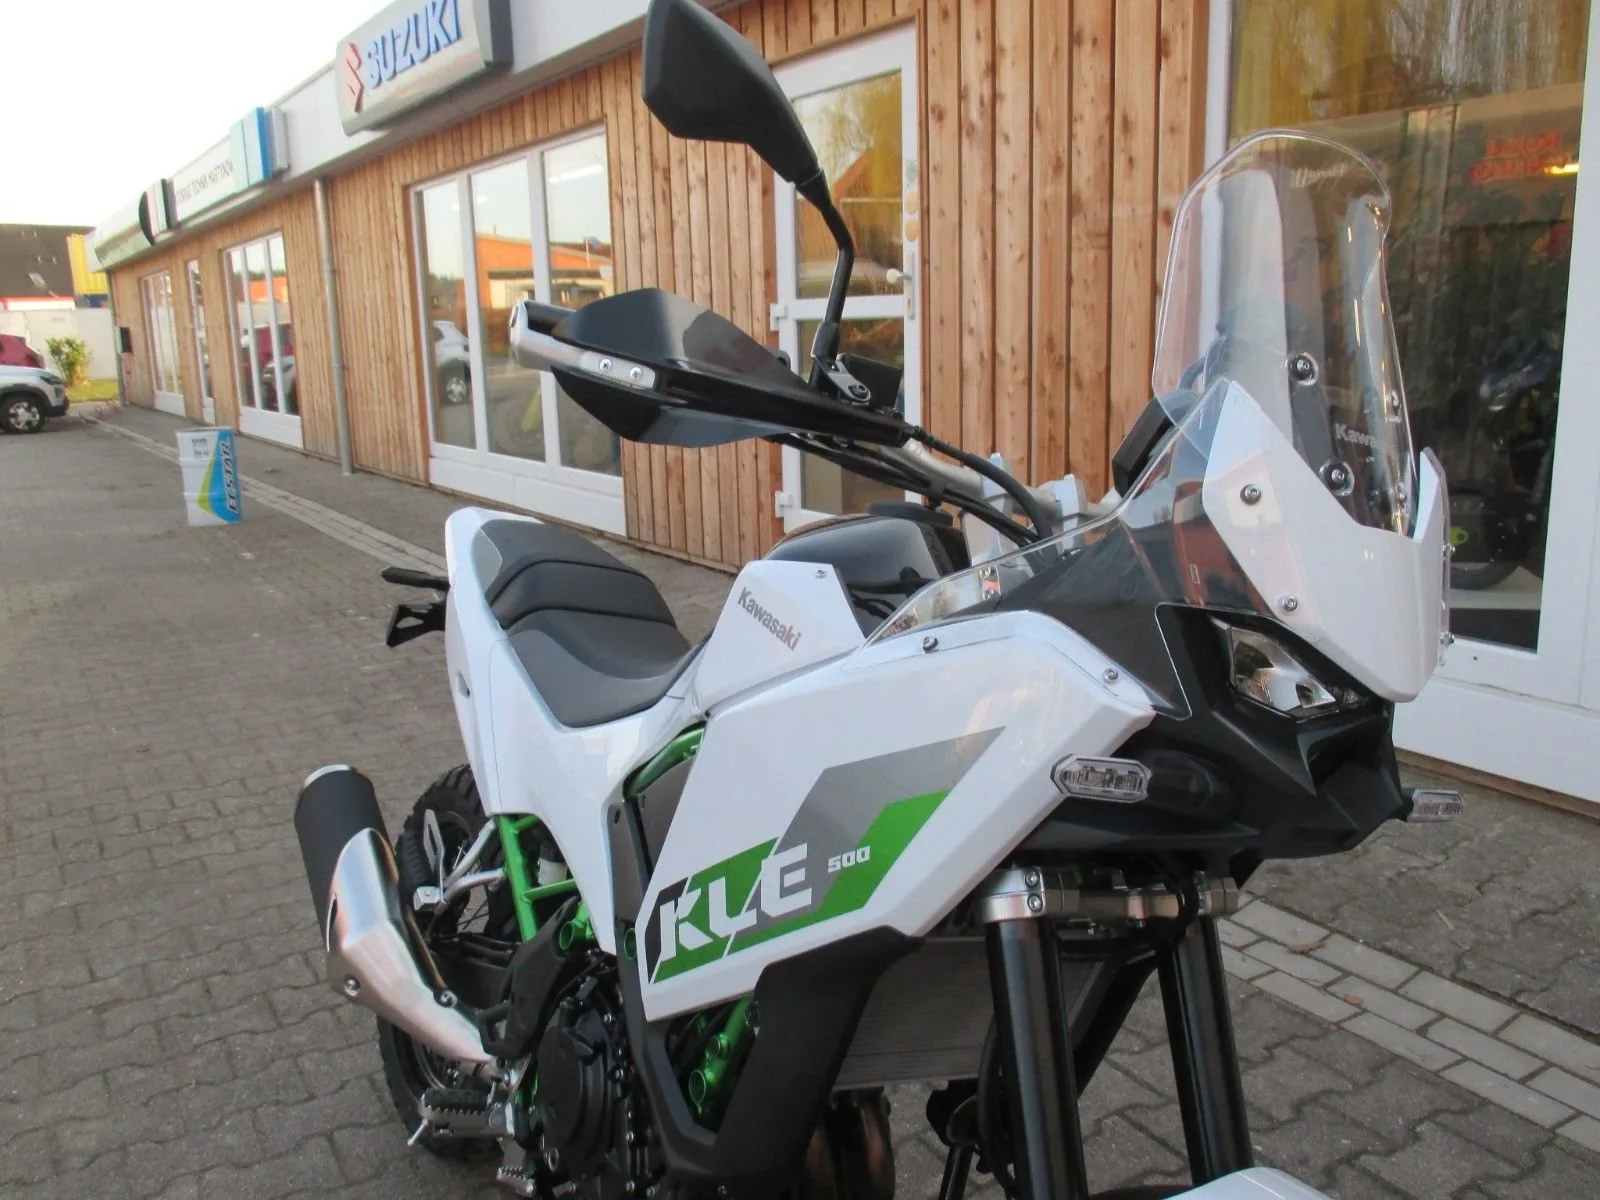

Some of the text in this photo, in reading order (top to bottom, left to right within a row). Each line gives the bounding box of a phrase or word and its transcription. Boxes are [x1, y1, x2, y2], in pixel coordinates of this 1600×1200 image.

[364, 0, 462, 90] SUZUKI
[738, 587, 802, 652] Kawasaki
[659, 843, 871, 962] KLE 500
